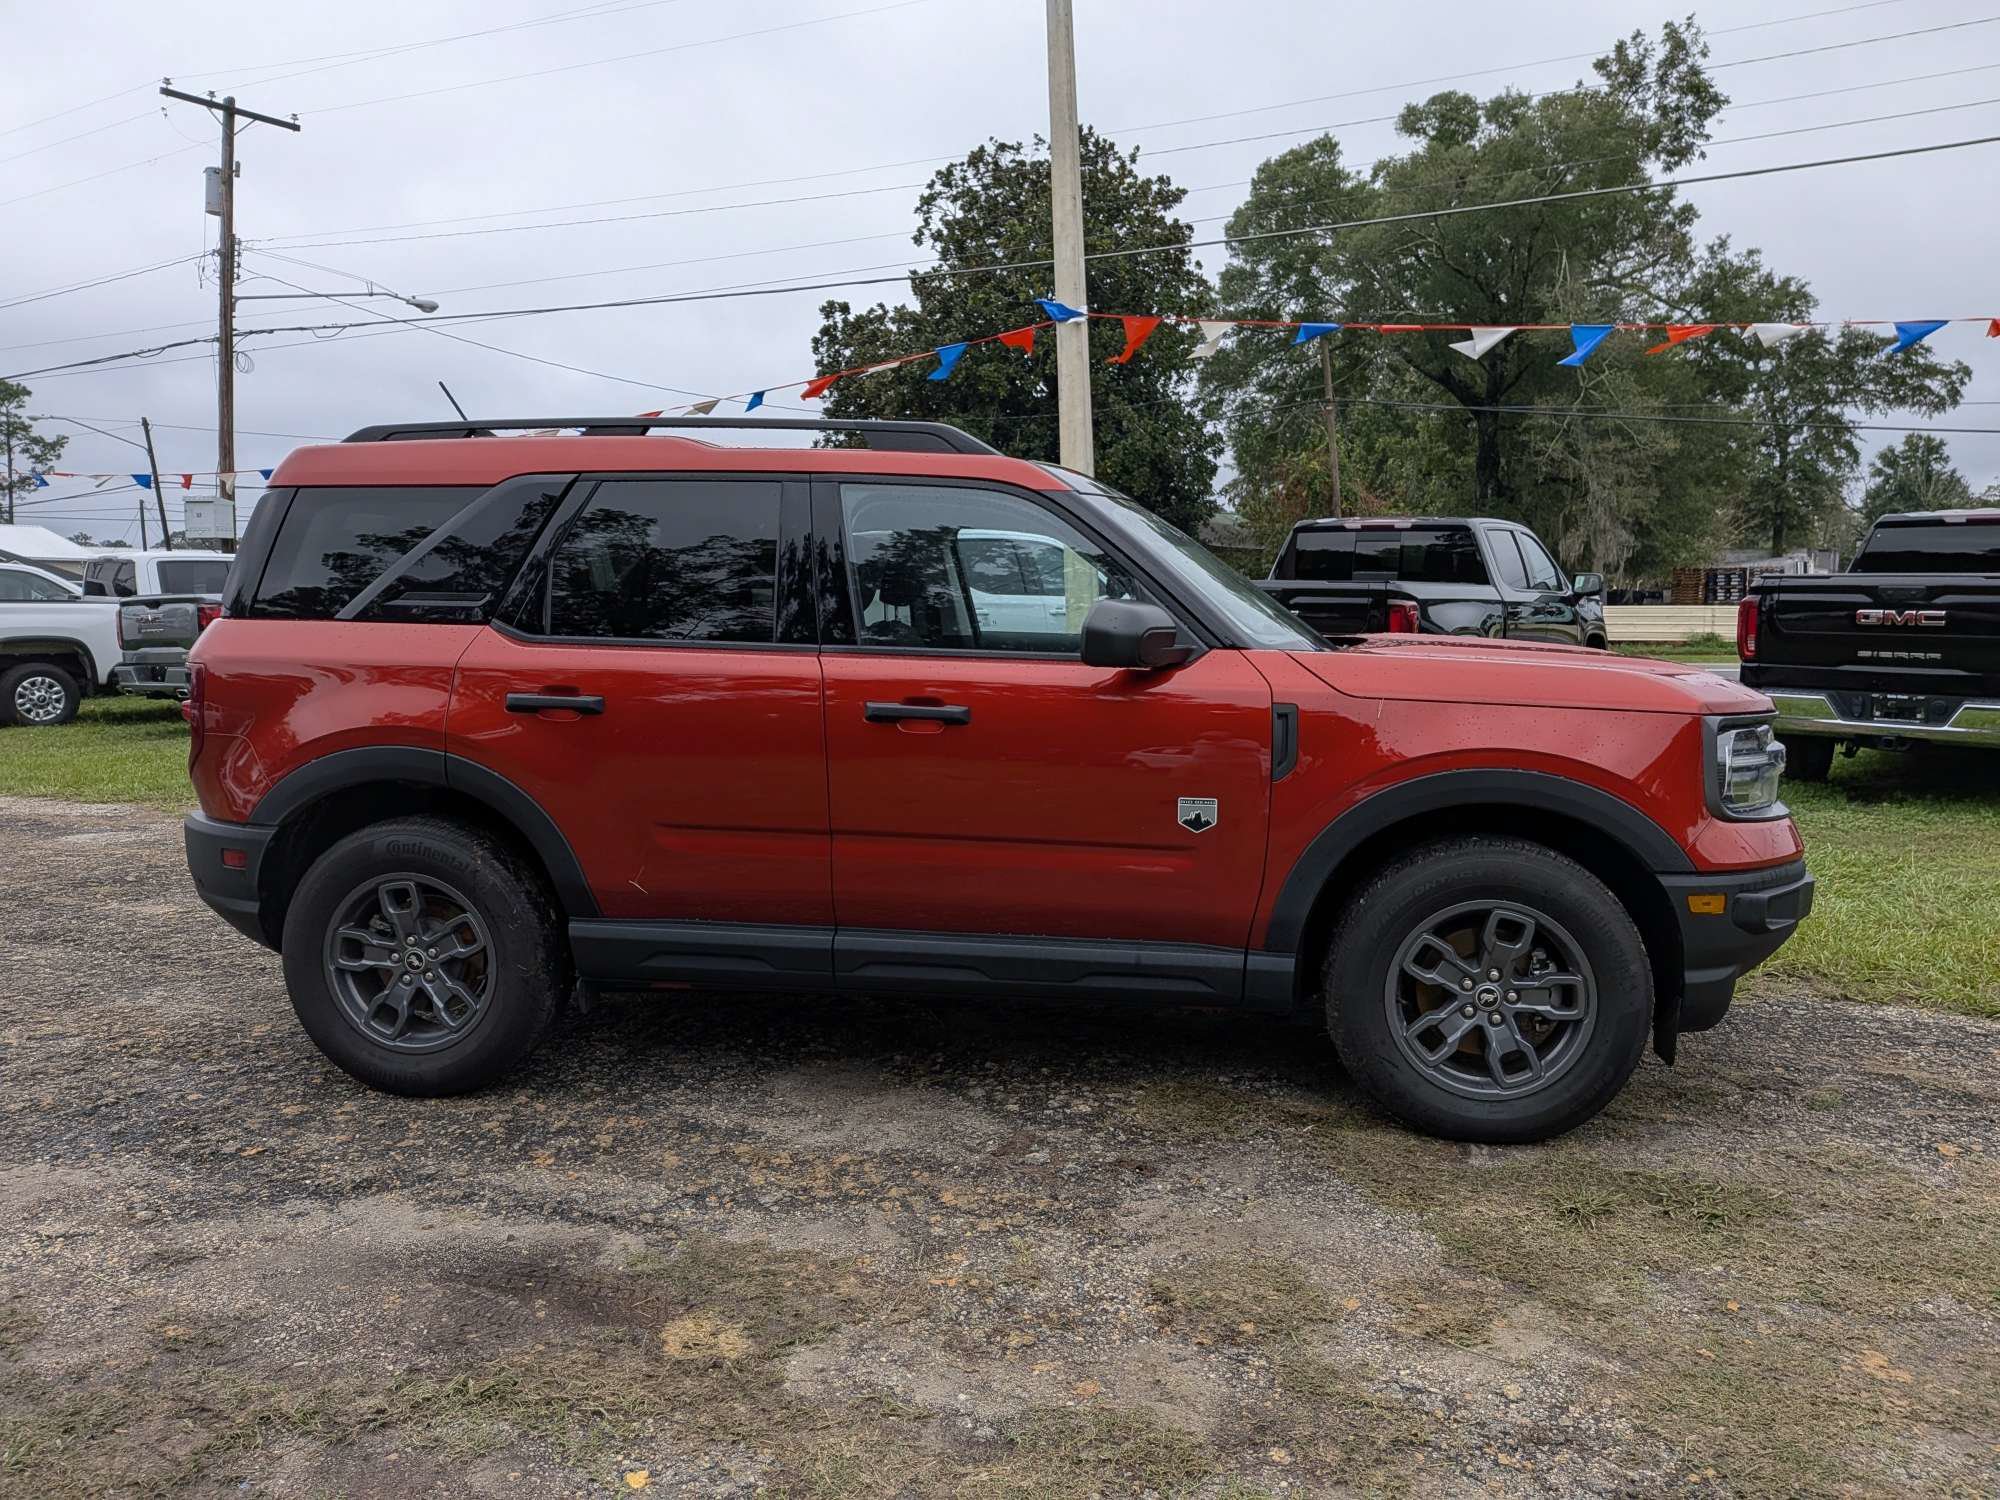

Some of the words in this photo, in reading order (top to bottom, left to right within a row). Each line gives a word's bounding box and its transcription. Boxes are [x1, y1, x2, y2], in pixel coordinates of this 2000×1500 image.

[1856, 609, 1946, 626] GMC
[1857, 651, 1942, 660] SIERRA
[387, 840, 471, 872] Continental
